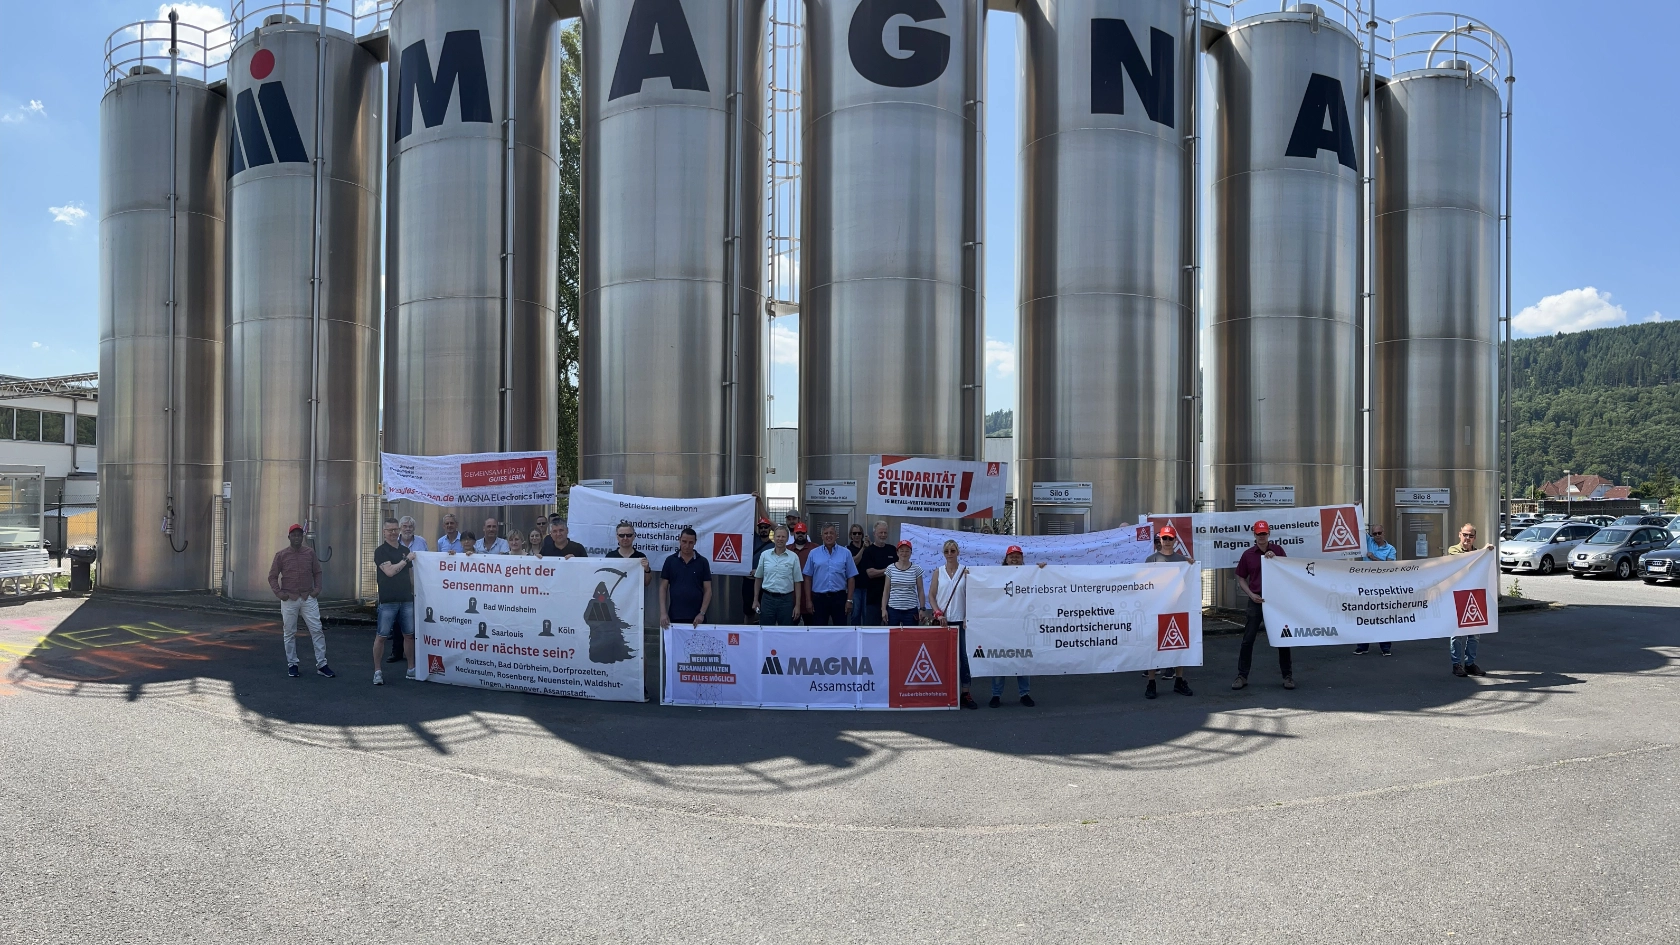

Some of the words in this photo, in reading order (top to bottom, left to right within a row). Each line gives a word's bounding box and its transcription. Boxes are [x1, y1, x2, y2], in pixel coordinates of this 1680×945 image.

[464, 468, 502, 478] GEMEINSAM
[878, 468, 956, 484] SOLIDARITÄT
[877, 481, 955, 499] GEWINNT
[458, 493, 490, 503] MAGNA
[661, 502, 698, 512] Heilbronn
[1196, 526, 1206, 534] IG
[1210, 524, 1240, 534] Metall
[1243, 520, 1319, 532] Veauensleute
[634, 532, 680, 541] eutschland
[661, 543, 673, 552] für
[1214, 540, 1250, 550] Magna
[1254, 536, 1304, 547] Sarlouis
[439, 561, 456, 571] Bei
[460, 562, 502, 574] MAGNA
[505, 564, 531, 577] geht
[535, 565, 556, 576] der
[1349, 566, 1399, 574] Betriebsrat
[442, 579, 514, 593] Sensenmann
[520, 586, 550, 595] um...
[1015, 584, 1067, 594] Betriebsrat
[1070, 581, 1154, 594] Untergruppenbach
[1358, 585, 1414, 597] Perspektive
[483, 603, 496, 611] Bad
[498, 604, 537, 614] Windsheim
[1342, 599, 1428, 612] Standortsicherung
[1057, 607, 1115, 619] Perspektive
[440, 615, 472, 625] Bopfingen
[1356, 614, 1416, 626] Deutschland
[492, 629, 524, 638] Saarlouis
[558, 626, 575, 634] Köln
[1039, 621, 1132, 634] Standortsicherung
[1294, 626, 1338, 637] MAGNA
[423, 634, 441, 646] Wer
[444, 639, 466, 650] wird
[470, 640, 489, 652] der
[492, 643, 540, 657] nächste
[542, 647, 575, 659] sein?
[1055, 636, 1118, 649] Deutschland
[986, 648, 1033, 658] MAGNA
[465, 658, 496, 668] Roitzsch,
[498, 661, 511, 669] Bad
[553, 666, 609, 677] Dorfprozelten,
[679, 665, 728, 673] ZUSAMMENHALTEN
[787, 657, 874, 676] MAGNA
[455, 666, 495, 678] Neckarsulm,
[497, 672, 536, 683] Rosenberg,
[537, 676, 582, 687] Neuenstein,
[584, 679, 623, 688] Waldshut-
[709, 674, 734, 682] MÖGLICH
[809, 680, 875, 692] Assamstadt
